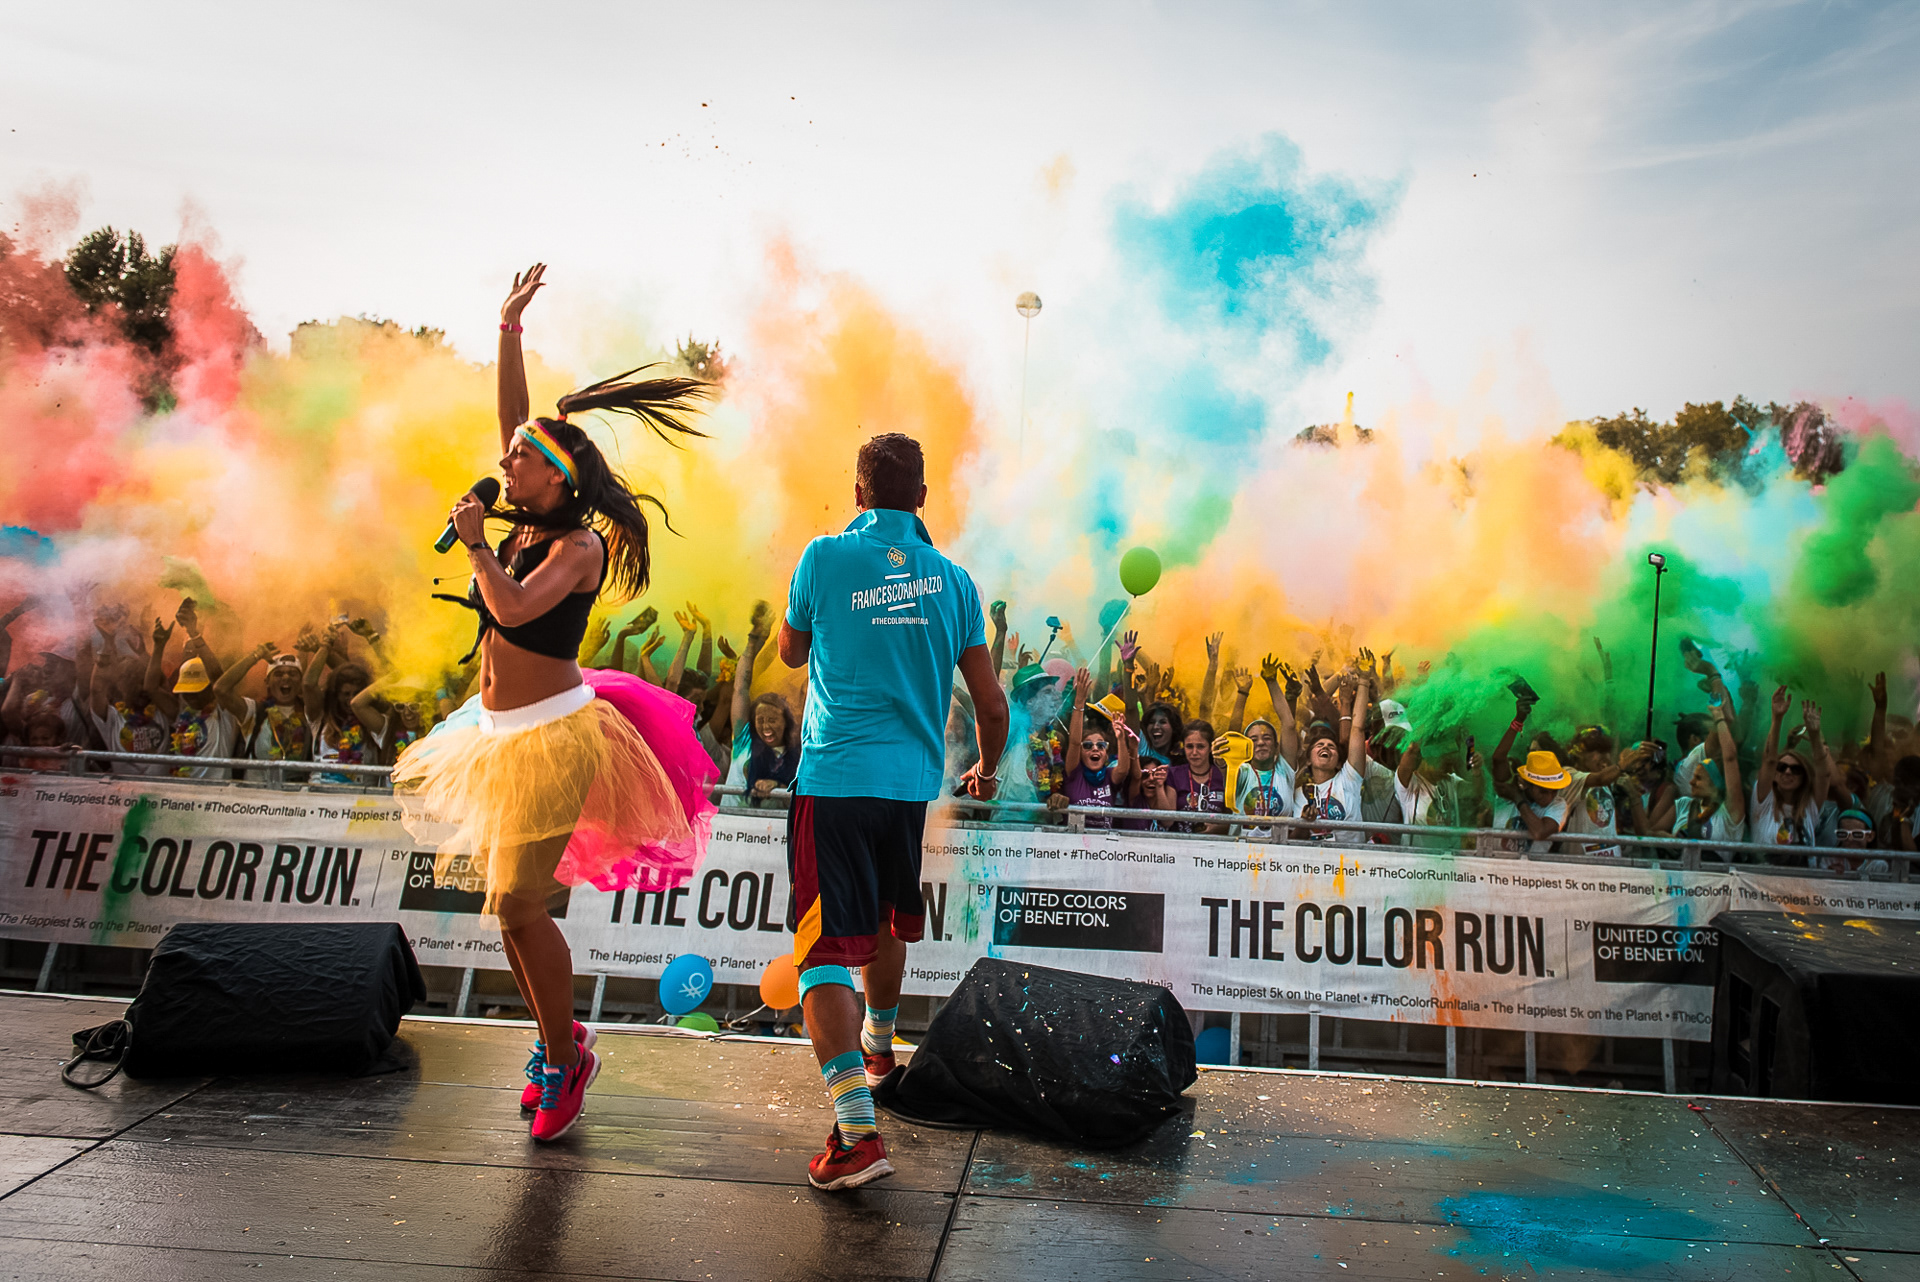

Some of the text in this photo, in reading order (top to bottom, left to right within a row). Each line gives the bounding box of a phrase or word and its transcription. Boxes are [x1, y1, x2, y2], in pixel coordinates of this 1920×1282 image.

[851, 575, 943, 611] FRANCESCORANDAZZO
[36, 791, 55, 802] The
[58, 792, 105, 806] Happiest
[107, 795, 121, 806] 5k
[124, 799, 138, 808] on
[161, 800, 194, 811] Planet
[204, 801, 306, 817] #TheColorRunItalia
[318, 808, 338, 819] The
[341, 809, 389, 821] Happiest
[716, 831, 733, 841] the
[736, 832, 771, 844] Planet
[391, 850, 408, 861] BY
[971, 844, 985, 857] 5k
[988, 848, 1001, 857] on
[1005, 847, 1022, 857] the
[1026, 847, 1061, 860] Planet
[1070, 849, 1176, 865] #TheColorRunItalia
[24, 829, 114, 892] THE
[111, 835, 264, 902] COLOR
[263, 844, 363, 906] RUN
[413, 857, 471, 874] UNED
[409, 873, 433, 888] OF
[1193, 857, 1214, 868] The
[1218, 858, 1266, 872] Happiest
[1269, 861, 1283, 872] 5k
[1286, 864, 1300, 873] on
[1303, 863, 1320, 875] the
[1324, 864, 1358, 877] Planet
[1369, 867, 1476, 884] #TheColorRunItalia
[1487, 874, 1508, 885] The
[1513, 875, 1562, 890] Happiest
[1565, 879, 1579, 890] 5k
[1582, 882, 1595, 891] on
[1599, 882, 1616, 893] the
[1620, 882, 1655, 896] Planet
[977, 884, 994, 895] BY
[1738, 887, 1758, 900] The
[1761, 892, 1810, 906] Happiest
[1813, 896, 1827, 907] 5k
[1830, 899, 1844, 908] on
[1846, 898, 1865, 910] the
[1868, 898, 1905, 911] Planet
[1001, 891, 1127, 911] UNITED COLORS
[0, 913, 162, 934] The Happiest 5k on the Planet
[999, 909, 1110, 928] OF BENETTON.
[1573, 920, 1590, 931] BY
[418, 936, 455, 950] Planet
[1201, 896, 1285, 961] THE
[1295, 902, 1445, 970] COLOR
[1454, 911, 1545, 978] RUN
[1597, 928, 1719, 946] UNITED COLORS
[589, 949, 610, 961] The
[612, 950, 663, 965] Happiest
[720, 956, 756, 970] Planet
[1598, 946, 1705, 963] OF BENETTON.
[910, 968, 961, 982] Happiest
[1191, 983, 1213, 995] The
[1216, 984, 1267, 999] Happiest
[1269, 987, 1284, 999] 5k
[1286, 990, 1301, 1000] on
[1304, 989, 1322, 1001] the
[1325, 990, 1361, 1004] Planet
[1370, 994, 1480, 1012] #TheColorRunItalia
[1491, 1001, 1514, 1014] The
[1517, 1003, 1567, 1018] Happiest
[1570, 1007, 1584, 1019] 5k
[1587, 1010, 1601, 1019] on
[1604, 1009, 1623, 1021] the
[1626, 1009, 1663, 1022] Planet
